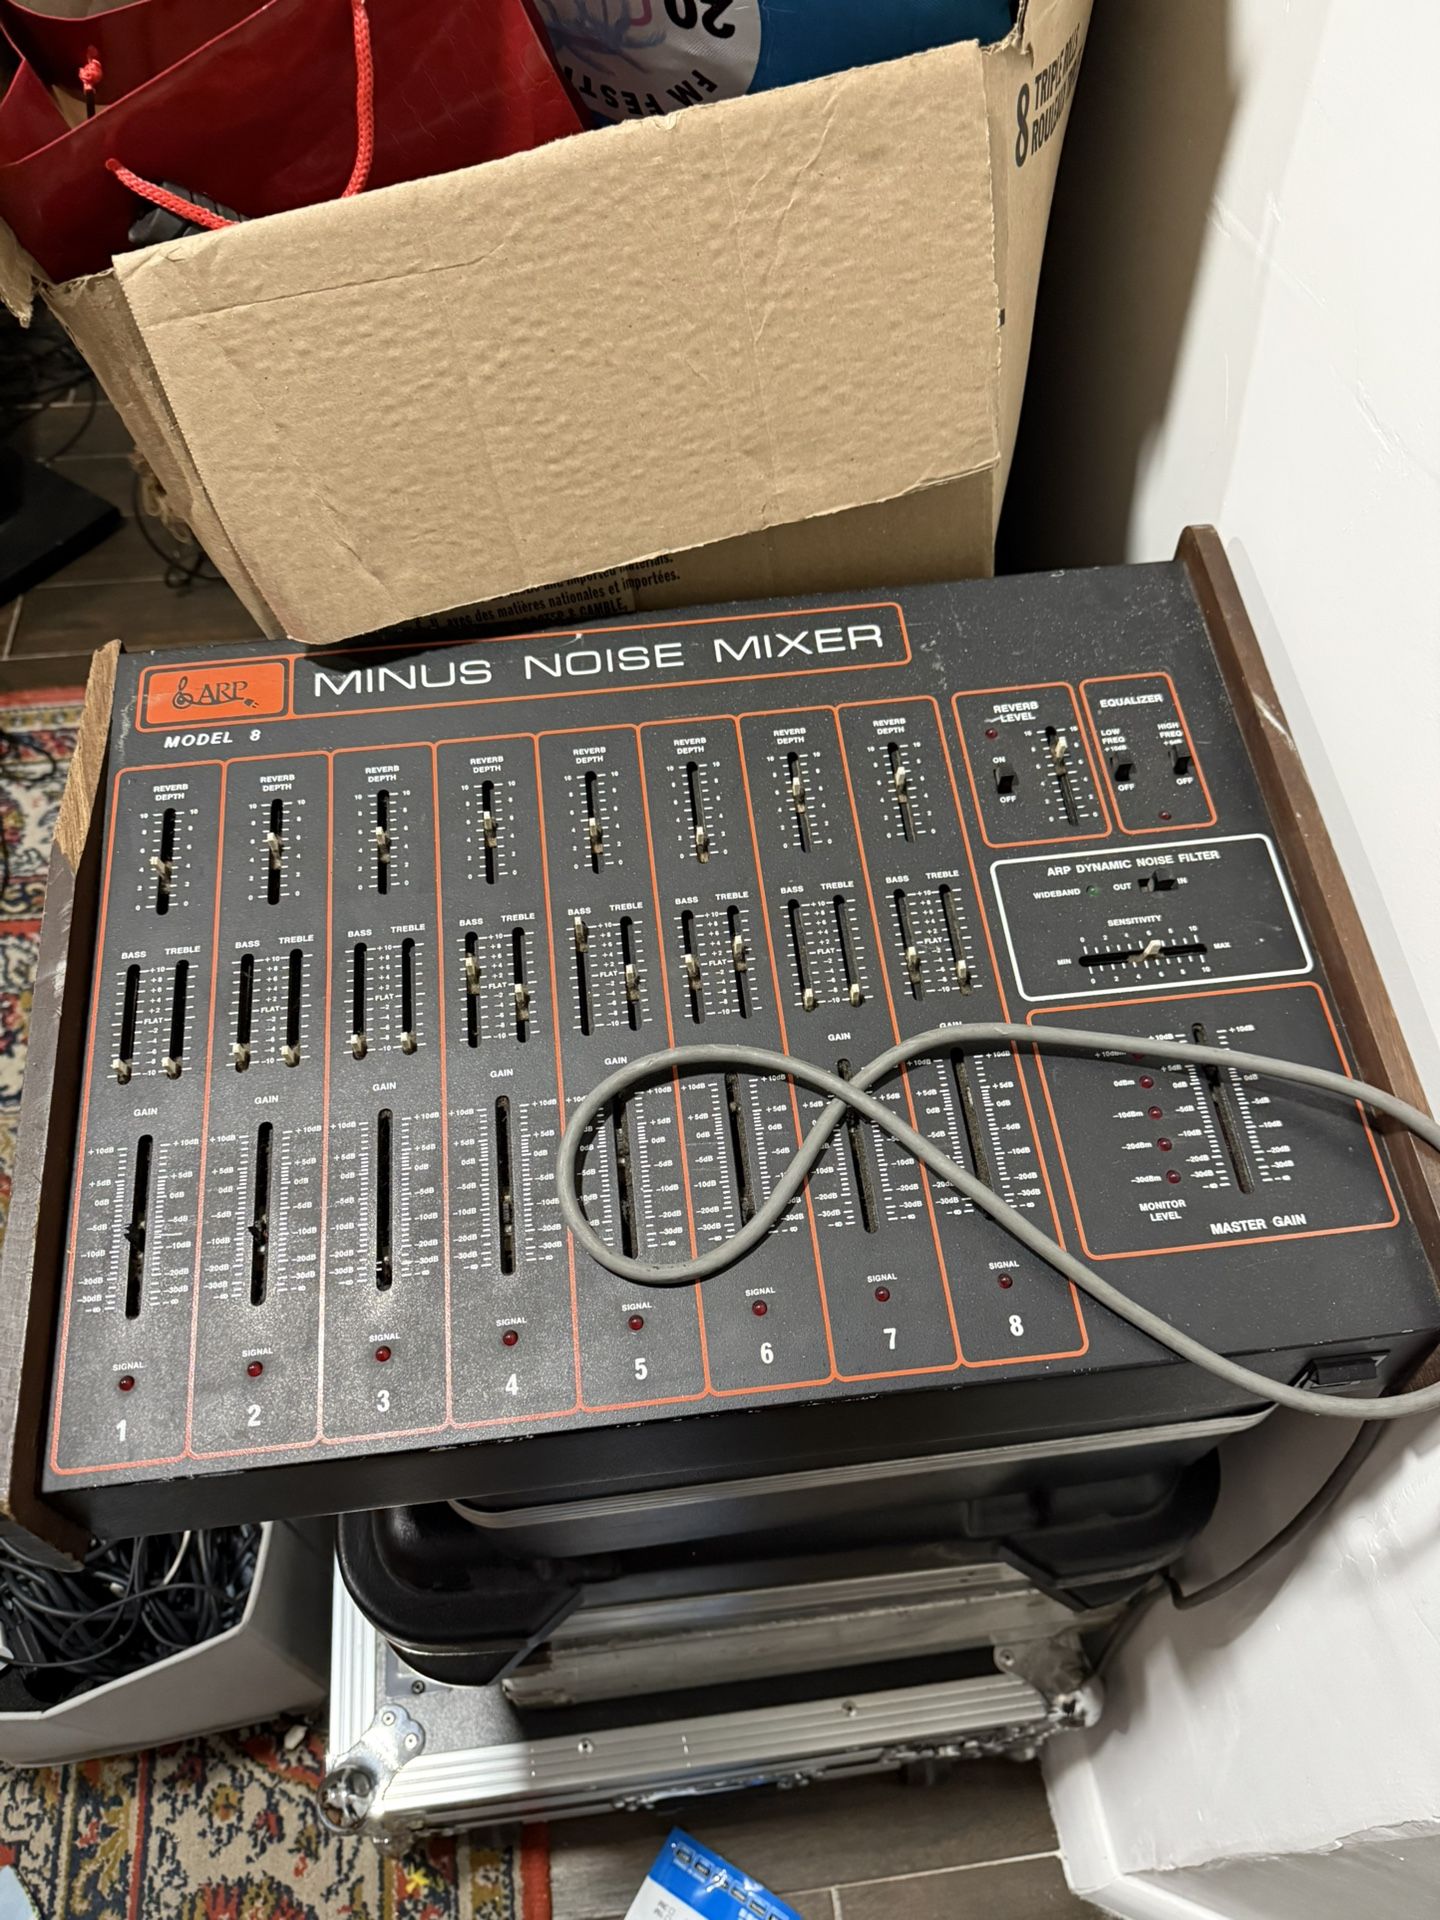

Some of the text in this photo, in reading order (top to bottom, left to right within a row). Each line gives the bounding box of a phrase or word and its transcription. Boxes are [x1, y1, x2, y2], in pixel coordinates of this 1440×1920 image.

[1015, 83, 1030, 168] 8
[1034, 48, 1064, 111] TRIPLE
[475, 608, 495, 622] des
[496, 600, 546, 619] matières
[549, 586, 606, 608] nationales
[609, 581, 620, 596] et
[622, 570, 680, 591] importées.
[313, 624, 885, 698] MINUS NOISE MIXER
[200, 680, 249, 706] ARP
[1100, 694, 1164, 708] EQUALIZER
[993, 701, 1039, 713] REVERB
[872, 718, 906, 727] REVERB
[1000, 712, 1036, 723] LEVEL
[877, 727, 904, 735] DEPTH
[1157, 722, 1180, 730] HIGH
[773, 728, 806, 736] REVERB
[1100, 728, 1120, 736] LOW
[1159, 730, 1183, 738] FREQ
[164, 729, 262, 749] MODEL 8
[674, 737, 706, 746] REVERB
[777, 736, 804, 744] DEPTH
[1102, 736, 1126, 744] FREQ
[573, 746, 606, 756] REVERB
[677, 746, 704, 754] DEPTH
[470, 756, 504, 765] REVERB
[576, 756, 604, 764] DEPTH
[992, 756, 1006, 764] ON
[365, 765, 400, 774] REVERB
[473, 766, 501, 774] DEPTH
[260, 774, 295, 783] REVERB
[368, 774, 396, 782] DEPTH
[1176, 777, 1194, 786] OFF
[153, 783, 188, 792] REVERB
[262, 783, 292, 792] DEPTH
[1118, 784, 1136, 792] OFF
[155, 793, 185, 801] DEPTH
[1000, 796, 1016, 804] OFF
[1047, 850, 1220, 878] ARP DYNAMIC NOISE FILTER
[886, 870, 960, 884] BASS TREBLE
[780, 880, 854, 894] BASS TREBLE
[1033, 876, 1188, 900] WIDEBAND OUT IN
[675, 891, 749, 906] BASS TREBLE
[568, 902, 644, 916] BASS TREBLE
[459, 912, 535, 926] BASS TREBLE
[1108, 914, 1162, 927] SENSITIVITY
[348, 923, 426, 938] BASS TREBLE
[235, 934, 314, 948] BASS TREBLE
[924, 936, 942, 944] FLAT
[1213, 942, 1232, 950] MAX
[121, 946, 200, 960] BASS TREBLE
[709, 958, 728, 966] FLAT
[1056, 958, 1072, 966] MIN
[600, 970, 618, 978] FLAT
[375, 993, 394, 1001] FLAT
[828, 1032, 851, 1042] GAIN
[604, 1056, 628, 1066] GAIN
[490, 1069, 514, 1078] GAIN
[372, 1082, 396, 1092] GAIN
[1114, 1080, 1135, 1088] 0dBm
[254, 1095, 278, 1105] GAIN
[134, 1108, 158, 1116] GAIN
[652, 1136, 666, 1144] 0dB
[1139, 1199, 1187, 1212] MONITOR
[1150, 1212, 1182, 1222] LEVEL
[1210, 1214, 1307, 1236] MASTER GAIN
[988, 1260, 1020, 1270] SIGNAL
[867, 1273, 898, 1283] SIGNAL
[745, 1288, 776, 1296] SIGNAL
[622, 1302, 652, 1312] SIGNAL
[496, 1317, 528, 1327] SIGNAL
[1008, 1314, 1024, 1337] 8
[369, 1332, 400, 1342] SIGNAL
[883, 1328, 897, 1350] 7
[242, 1348, 274, 1358] SIGNAL
[760, 1342, 774, 1364] 6
[112, 1362, 144, 1372] SIGNAL
[634, 1358, 648, 1380] 5
[505, 1374, 519, 1396] 4
[376, 1390, 390, 1412] 3
[247, 1404, 262, 1427] 2
[116, 1420, 126, 1442] 1
